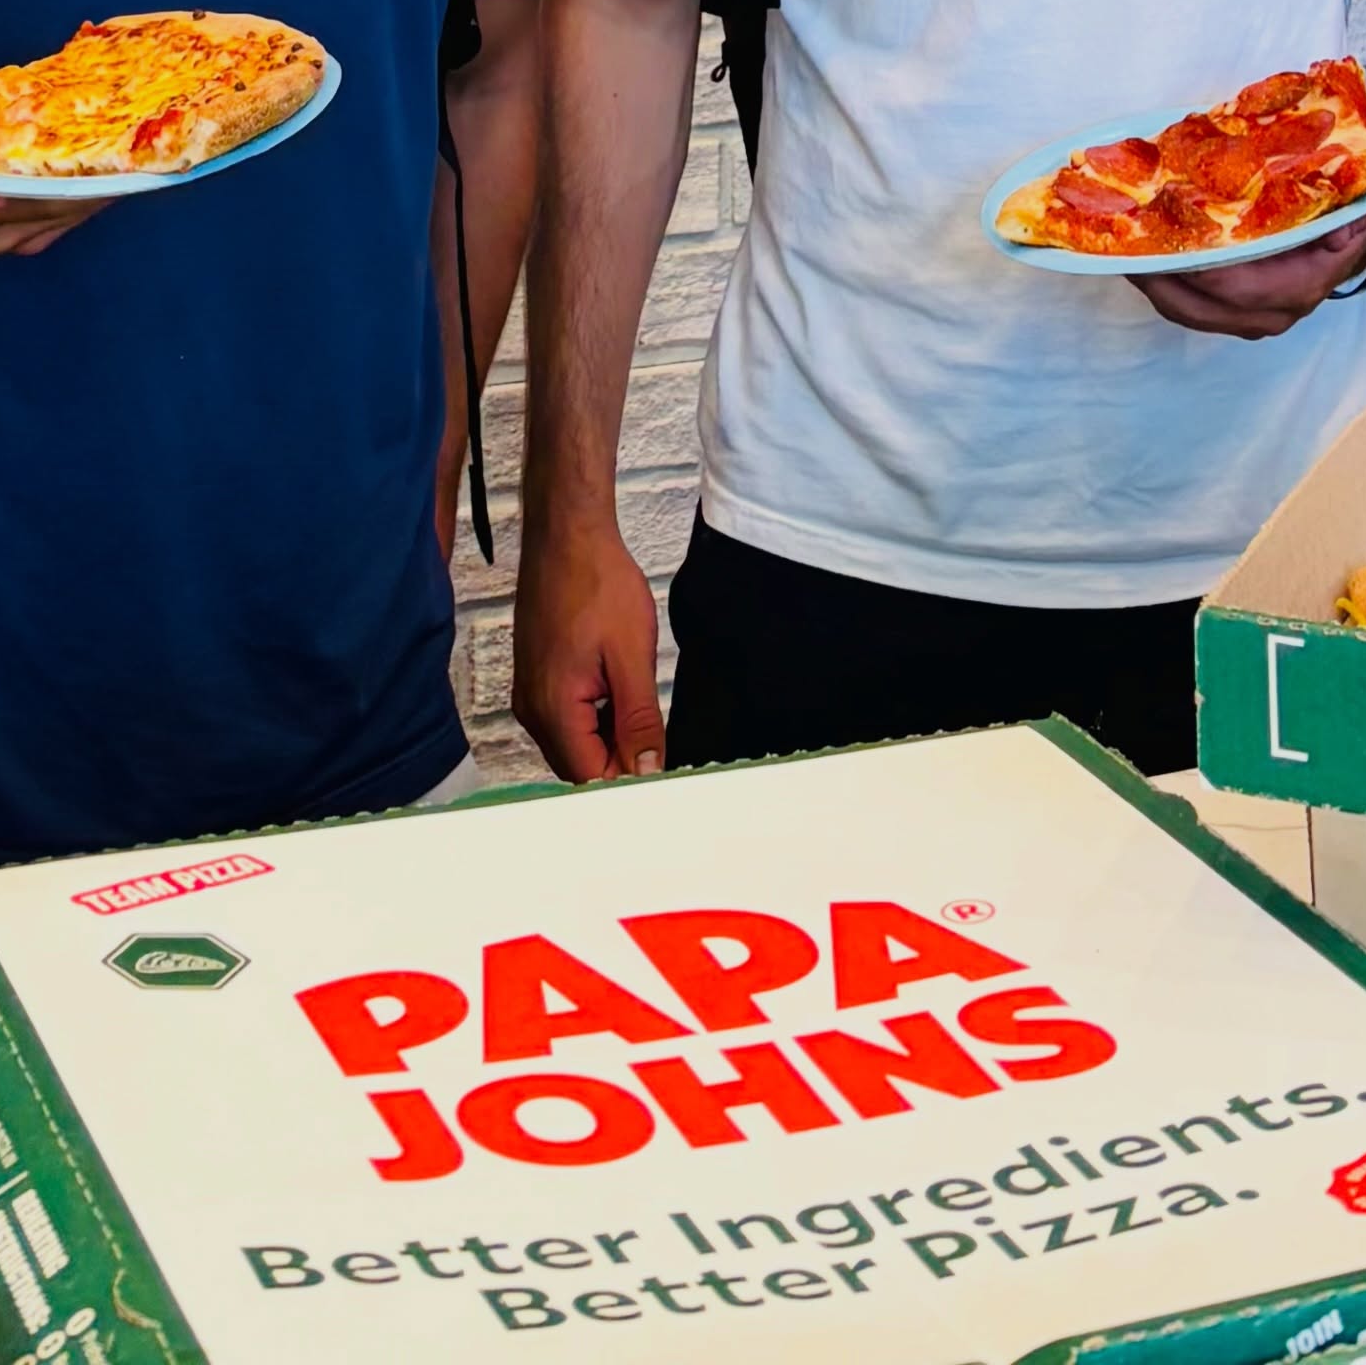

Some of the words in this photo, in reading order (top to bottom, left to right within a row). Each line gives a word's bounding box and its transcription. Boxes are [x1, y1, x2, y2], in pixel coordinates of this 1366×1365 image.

[80, 874, 180, 912] TEAM
[173, 856, 264, 889] PIZZA
[294, 901, 1030, 1078] PAPA
[367, 985, 1118, 1183] JOHNS
[240, 1231, 639, 1289] Better
[480, 1258, 875, 1331] Better
[905, 1190, 1259, 1280] Pizza.
[1286, 1308, 1344, 1363] JOIN
